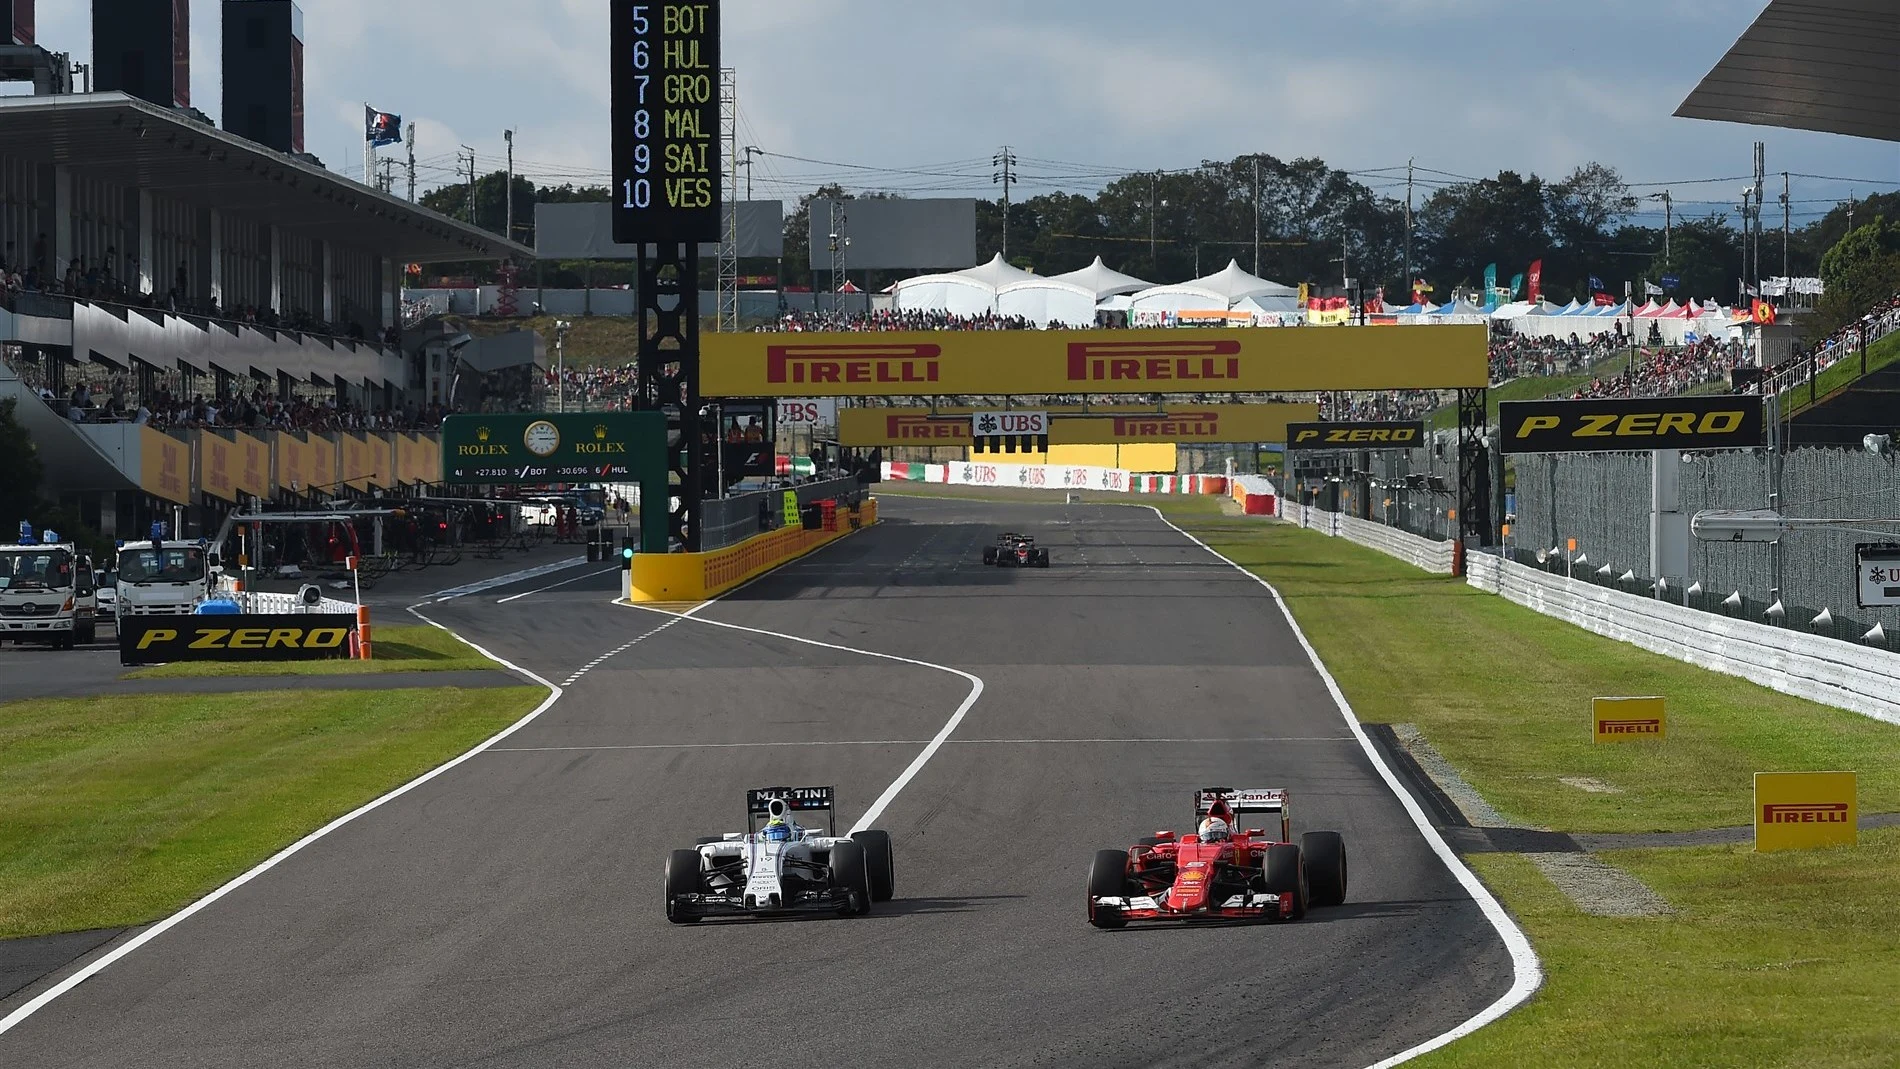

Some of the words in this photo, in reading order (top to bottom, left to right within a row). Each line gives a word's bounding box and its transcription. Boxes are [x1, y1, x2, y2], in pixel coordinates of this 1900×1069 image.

[633, 6, 649, 34] 5
[663, 5, 709, 34] BOT
[633, 40, 649, 69] 6
[663, 40, 710, 69] HUL
[634, 75, 650, 104] 7
[664, 74, 710, 103] GRO
[634, 109, 650, 139] 8
[664, 109, 711, 138] MAL
[634, 143, 650, 174] 9
[664, 143, 709, 173] SAI
[623, 179, 650, 208] 10
[665, 178, 711, 208] VES
[767, 344, 941, 383] PIRELLI
[1067, 340, 1242, 380] PIRELLI
[887, 415, 973, 438] PIREL
[999, 414, 1042, 432] UBS
[1113, 412, 1219, 436] PIRELLI
[1516, 416, 1560, 438] P
[1572, 411, 1745, 437] ZERO
[1296, 430, 1319, 443] P
[1324, 428, 1416, 443] ZERO
[458, 445, 508, 455] ROLEX
[576, 442, 625, 453] ROLEX
[530, 467, 547, 475] BOT
[556, 467, 588, 475] +30.696
[611, 466, 628, 474] HUL
[974, 466, 996, 483] UBS
[1028, 468, 1045, 485] UBS
[136, 629, 177, 649] P
[188, 628, 347, 648] ZERO
[1599, 719, 1660, 734] PIRELLI
[1763, 803, 1848, 823] PIRELLI
